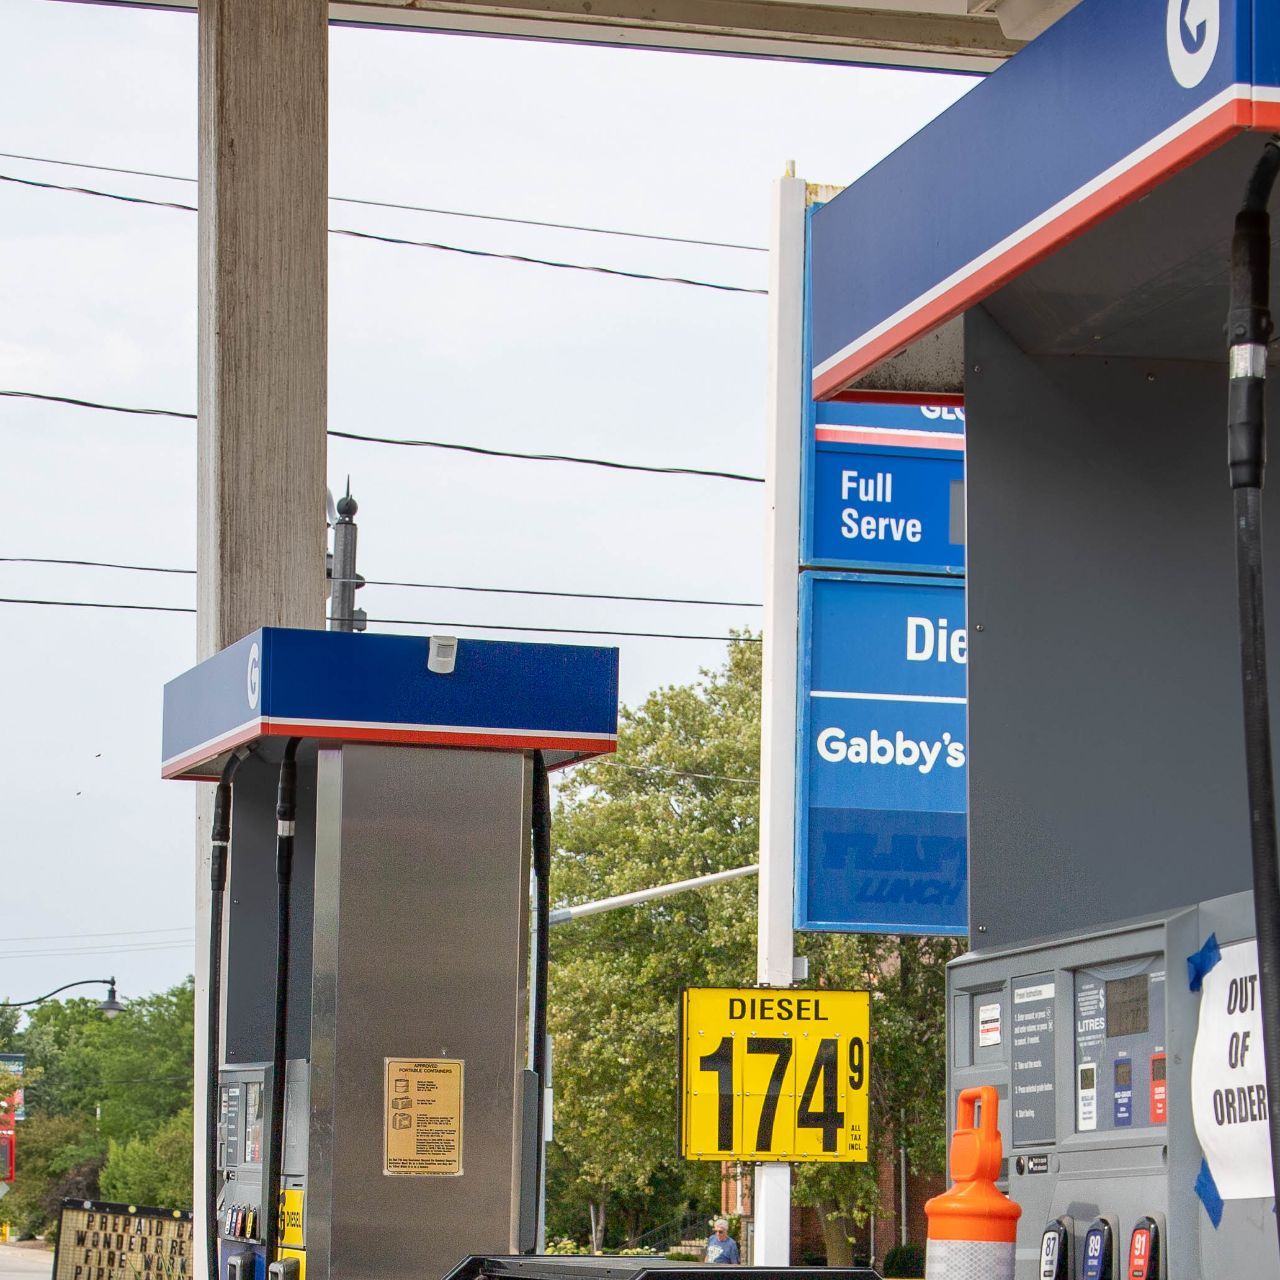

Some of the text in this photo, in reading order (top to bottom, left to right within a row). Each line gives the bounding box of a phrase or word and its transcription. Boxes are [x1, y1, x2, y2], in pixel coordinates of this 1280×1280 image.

[841, 470, 892, 503] Full
[841, 507, 922, 543] Serve
[906, 616, 967, 664] Die
[816, 727, 966, 774] Gabby's
[1227, 974, 1258, 1016] OUT
[729, 998, 828, 1021] DIESEL
[1077, 1017, 1105, 1033] LITRES
[1228, 1030, 1251, 1069] OF
[1213, 1084, 1268, 1127] ORDER
[850, 1124, 862, 1132] ALL
[850, 1134, 862, 1142] TAX
[86, 1213, 164, 1237] PREPAID
[286, 1211, 302, 1228] DIESEL
[75, 1230, 148, 1253] WONDER
[1045, 1236, 1057, 1257] 87
[1088, 1235, 1101, 1257] 89
[1134, 1233, 1147, 1256] 91
[84, 1248, 126, 1269] FIRE
